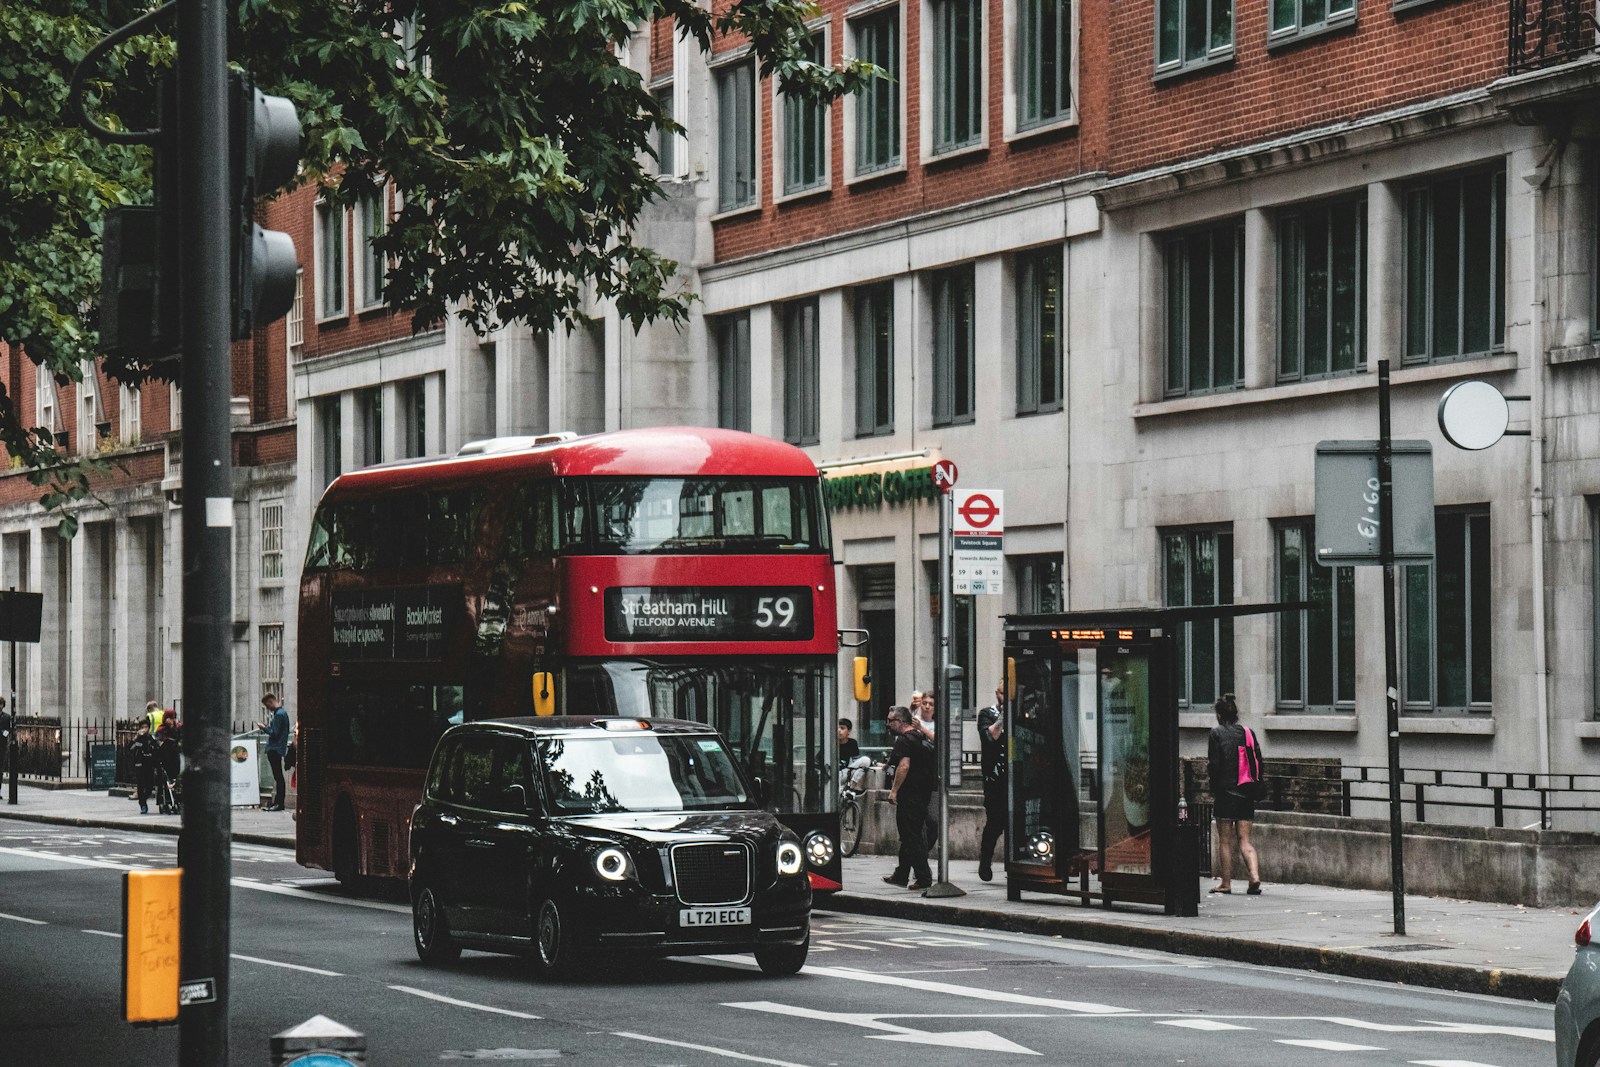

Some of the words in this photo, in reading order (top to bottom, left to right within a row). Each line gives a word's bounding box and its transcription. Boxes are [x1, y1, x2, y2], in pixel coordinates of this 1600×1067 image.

[935, 464, 954, 485] N
[621, 598, 697, 615] Streatham
[701, 598, 728, 616] Hill
[755, 597, 794, 628] 59
[633, 617, 676, 627] TELFORD
[677, 617, 716, 627] AVENUE
[687, 911, 716, 925] LT21
[720, 910, 744, 923] ECC
